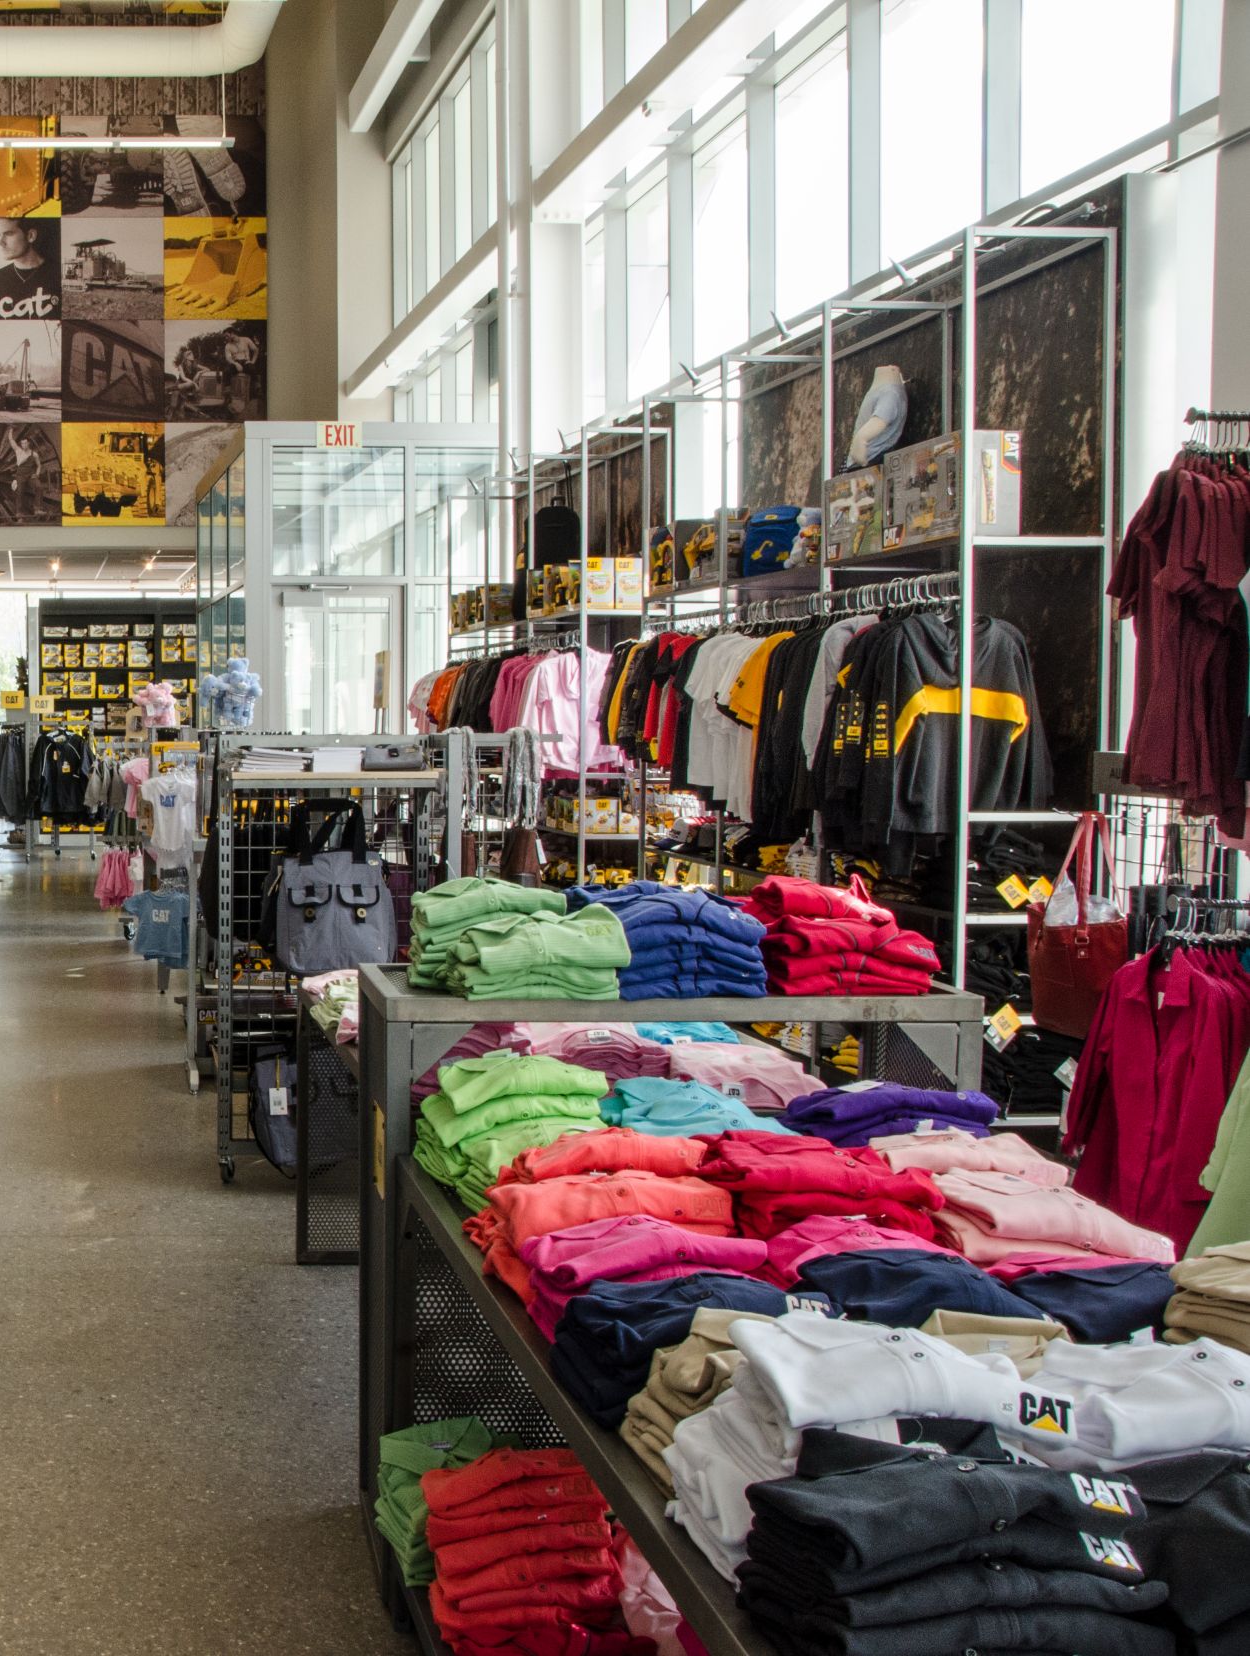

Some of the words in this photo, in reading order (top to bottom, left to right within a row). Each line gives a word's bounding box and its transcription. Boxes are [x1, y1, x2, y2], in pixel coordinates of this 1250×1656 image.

[69, 331, 155, 402] CAT
[325, 424, 356, 447] EXIT
[5, 695, 19, 704] CAT
[34, 700, 49, 709] CAT
[159, 794, 177, 808] CAT
[1003, 884, 1022, 903] CAT
[152, 908, 172, 923] CAT
[199, 1010, 218, 1022] CAT
[995, 1012, 1012, 1031] CAT
[1002, 1402, 1013, 1411] XS
[1019, 1392, 1071, 1434] CAT
[1070, 1472, 1127, 1516] CAT
[1079, 1531, 1143, 1571] CAT
